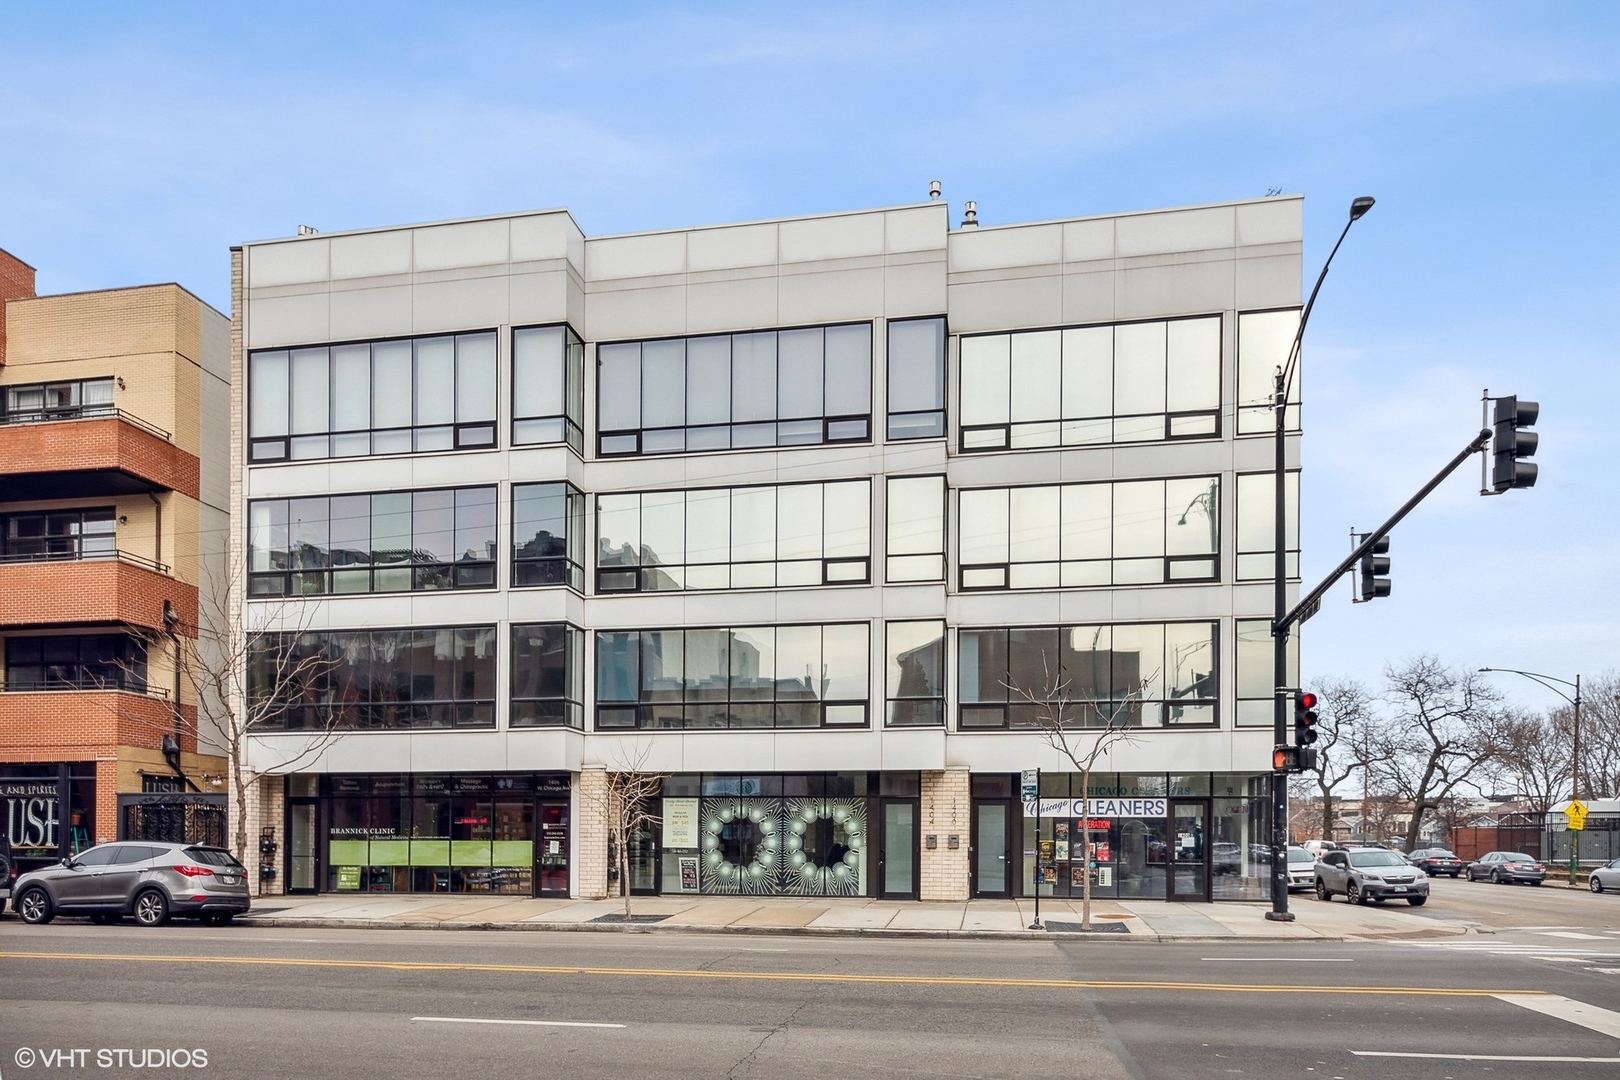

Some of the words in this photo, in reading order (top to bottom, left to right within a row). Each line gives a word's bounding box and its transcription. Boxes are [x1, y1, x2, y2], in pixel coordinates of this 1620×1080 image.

[7, 786, 25, 794] AND
[28, 785, 57, 795] SPIRITS
[1026, 800, 1068, 816] Chicago
[1073, 800, 1165, 816] CLEANERS
[7, 797, 59, 847] USH
[1077, 820, 1111, 829] AERATION
[370, 827, 396, 835] CLINIC
